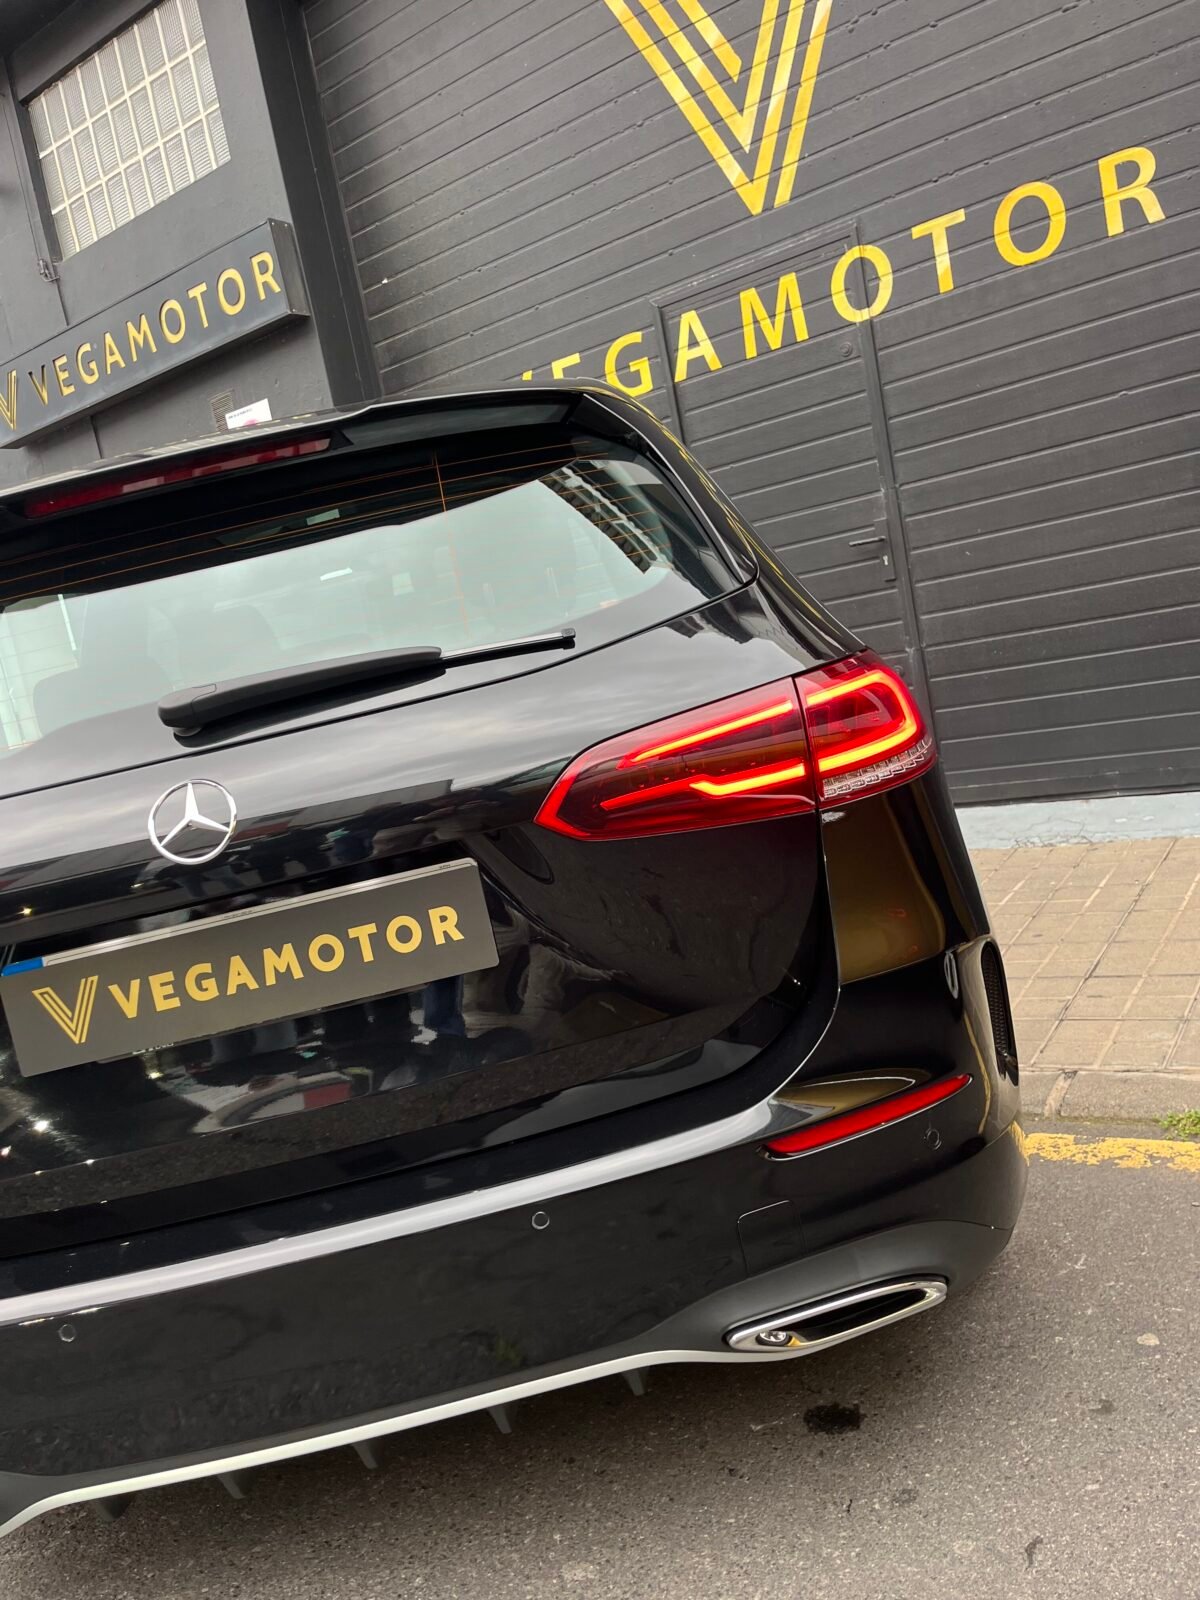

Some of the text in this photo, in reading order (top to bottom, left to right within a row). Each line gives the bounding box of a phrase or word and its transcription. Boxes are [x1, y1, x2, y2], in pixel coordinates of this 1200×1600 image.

[28, 251, 282, 407] VEGAMOTOR
[522, 146, 1166, 398] GAMOTOR
[109, 905, 465, 1019] VEGAMOTOR
